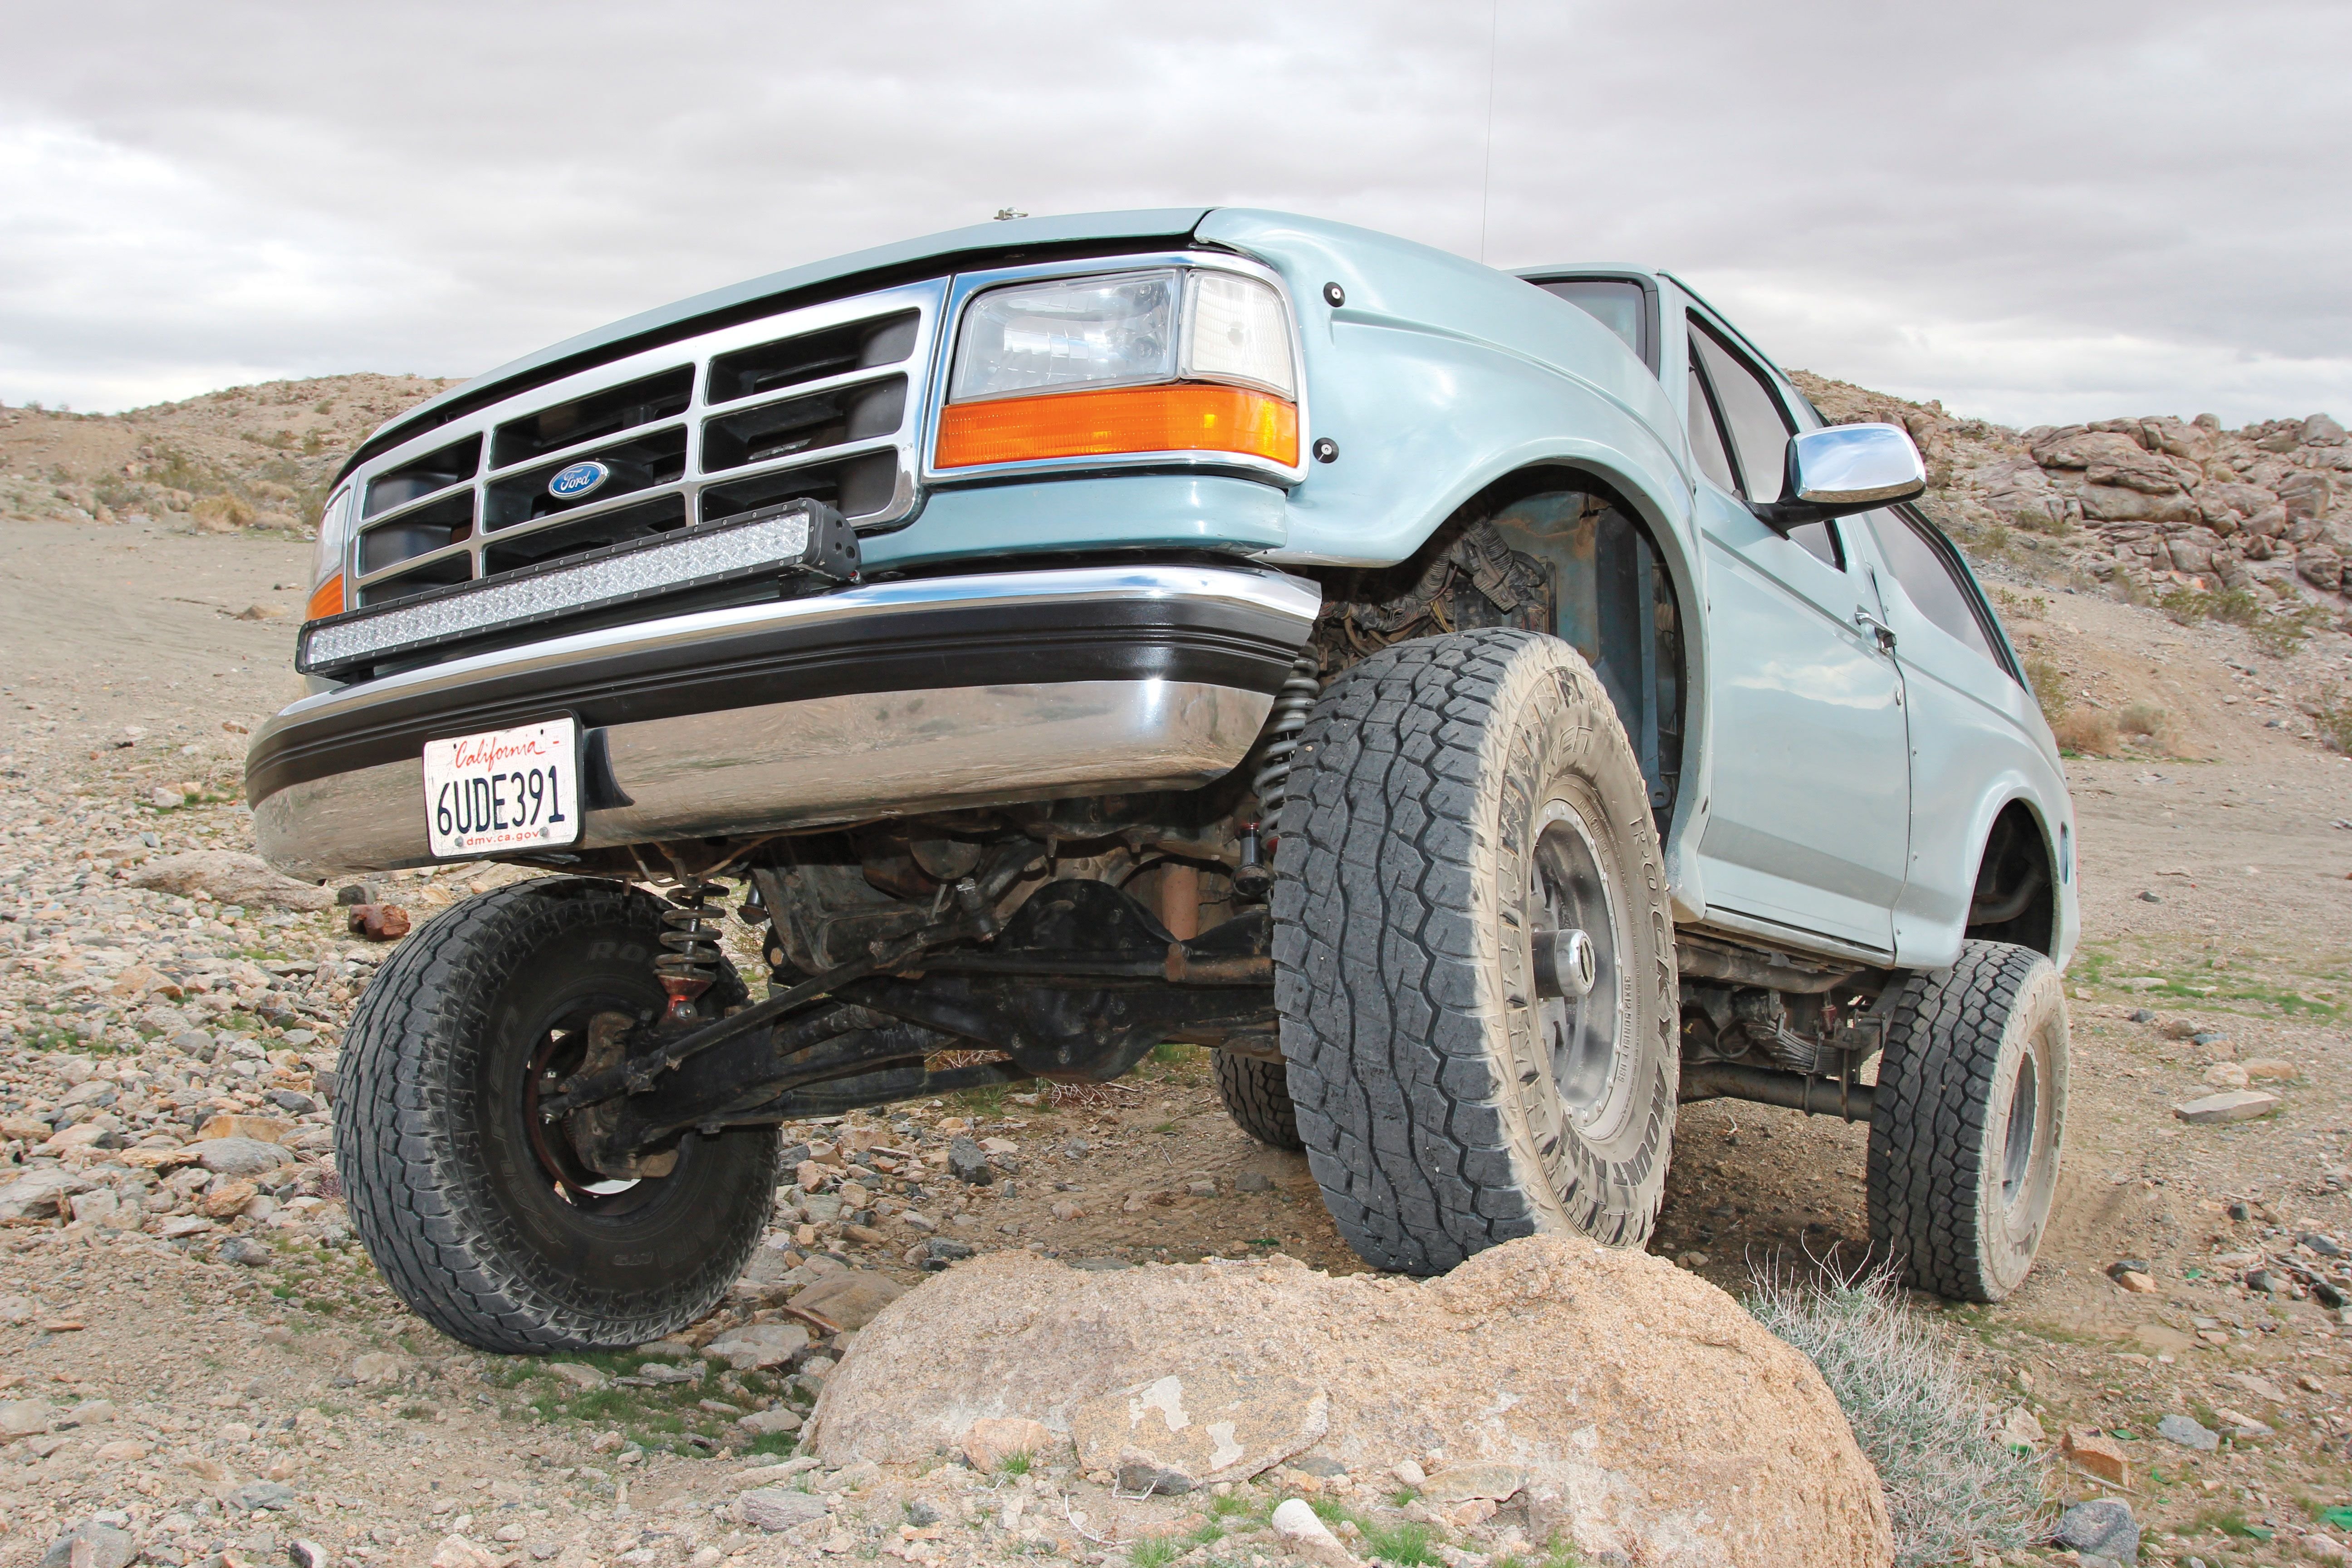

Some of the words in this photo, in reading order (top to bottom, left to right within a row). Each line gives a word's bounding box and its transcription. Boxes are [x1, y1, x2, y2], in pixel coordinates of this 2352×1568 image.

[560, 468, 591, 491] Ford
[456, 734, 546, 772] California
[437, 765, 565, 836] 6UDE391
[466, 829, 540, 847] dmv.ca.gov
